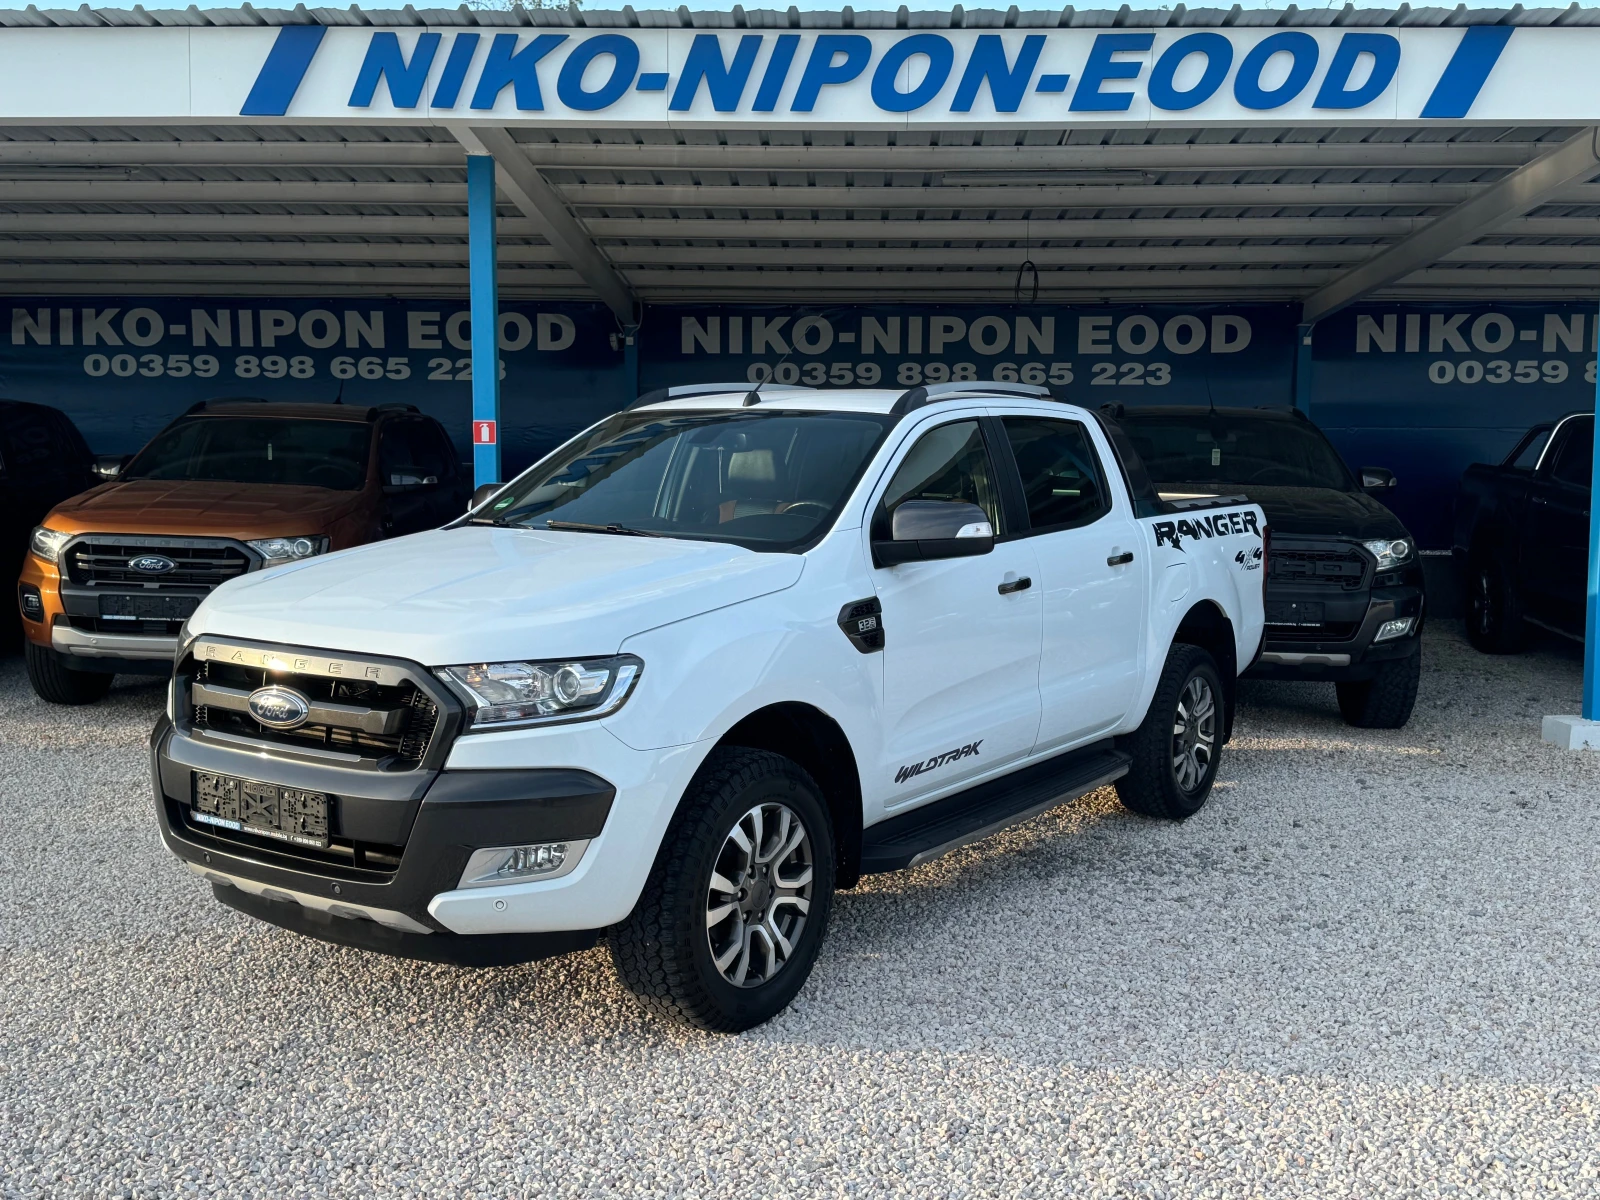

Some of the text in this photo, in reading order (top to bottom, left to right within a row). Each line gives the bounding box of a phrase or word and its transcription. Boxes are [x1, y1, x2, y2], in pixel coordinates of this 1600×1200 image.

[348, 31, 1401, 112] NIKO-NIPON-EOOD
[12, 308, 576, 351] NIKO-NIPON EOOD
[681, 315, 1252, 355] NIKO-NIPON EOOD
[83, 354, 506, 381] 00359 898 665 22
[746, 362, 1172, 386] 00359 898 665 223
[1428, 360, 1569, 384] 00359
[1152, 510, 1262, 554] RANGER
[139, 558, 163, 570] Ford
[205, 645, 382, 679] RANGER
[256, 694, 292, 720] Ford
[894, 739, 984, 784] WILDTRAK
